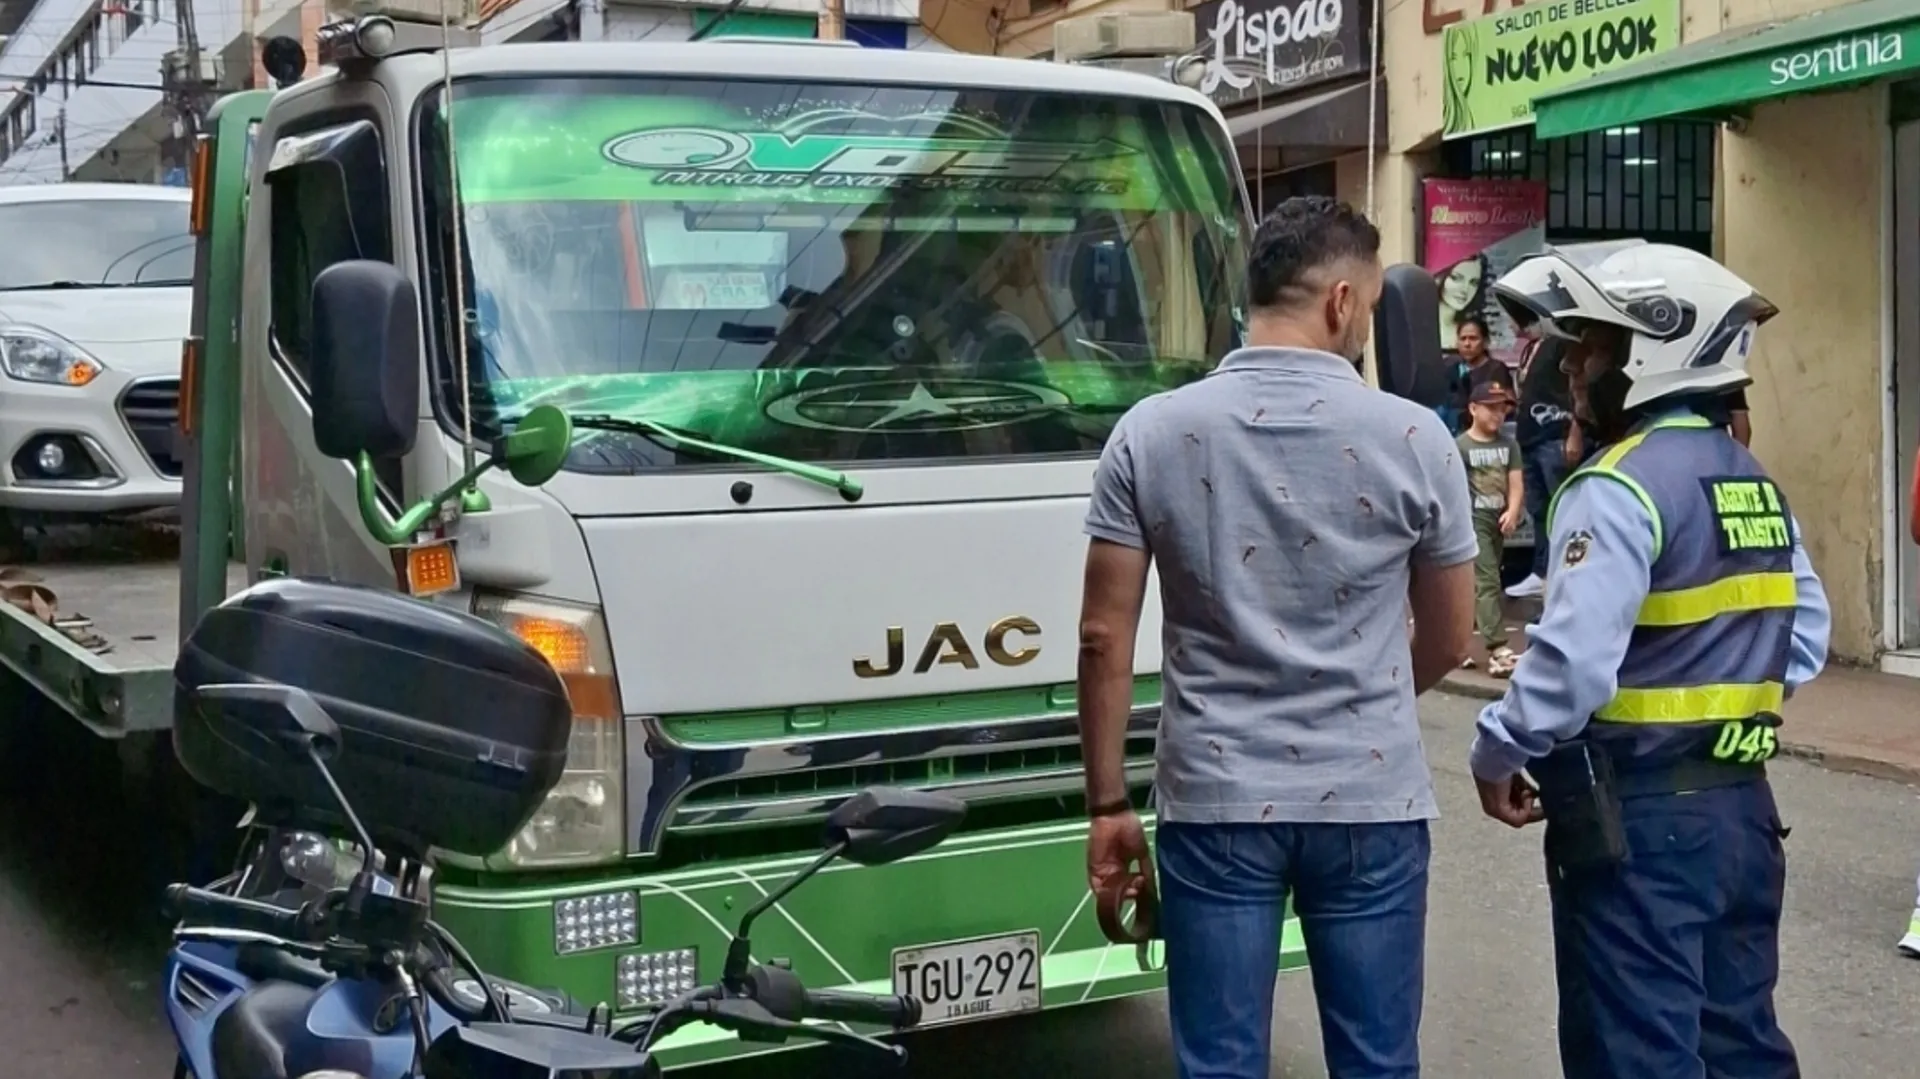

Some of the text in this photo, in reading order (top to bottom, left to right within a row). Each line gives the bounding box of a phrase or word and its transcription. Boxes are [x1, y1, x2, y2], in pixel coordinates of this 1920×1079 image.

[1495, 10, 1543, 36] SALON
[1548, 3, 1568, 22] DE
[1485, 30, 1577, 86] NUEVO
[1582, 14, 1657, 70] LOOK
[1712, 482, 1764, 513] AGENTE
[852, 615, 1042, 678] JAC
[1713, 721, 1777, 763] 045
[947, 1000, 992, 1018] IBAGUE
